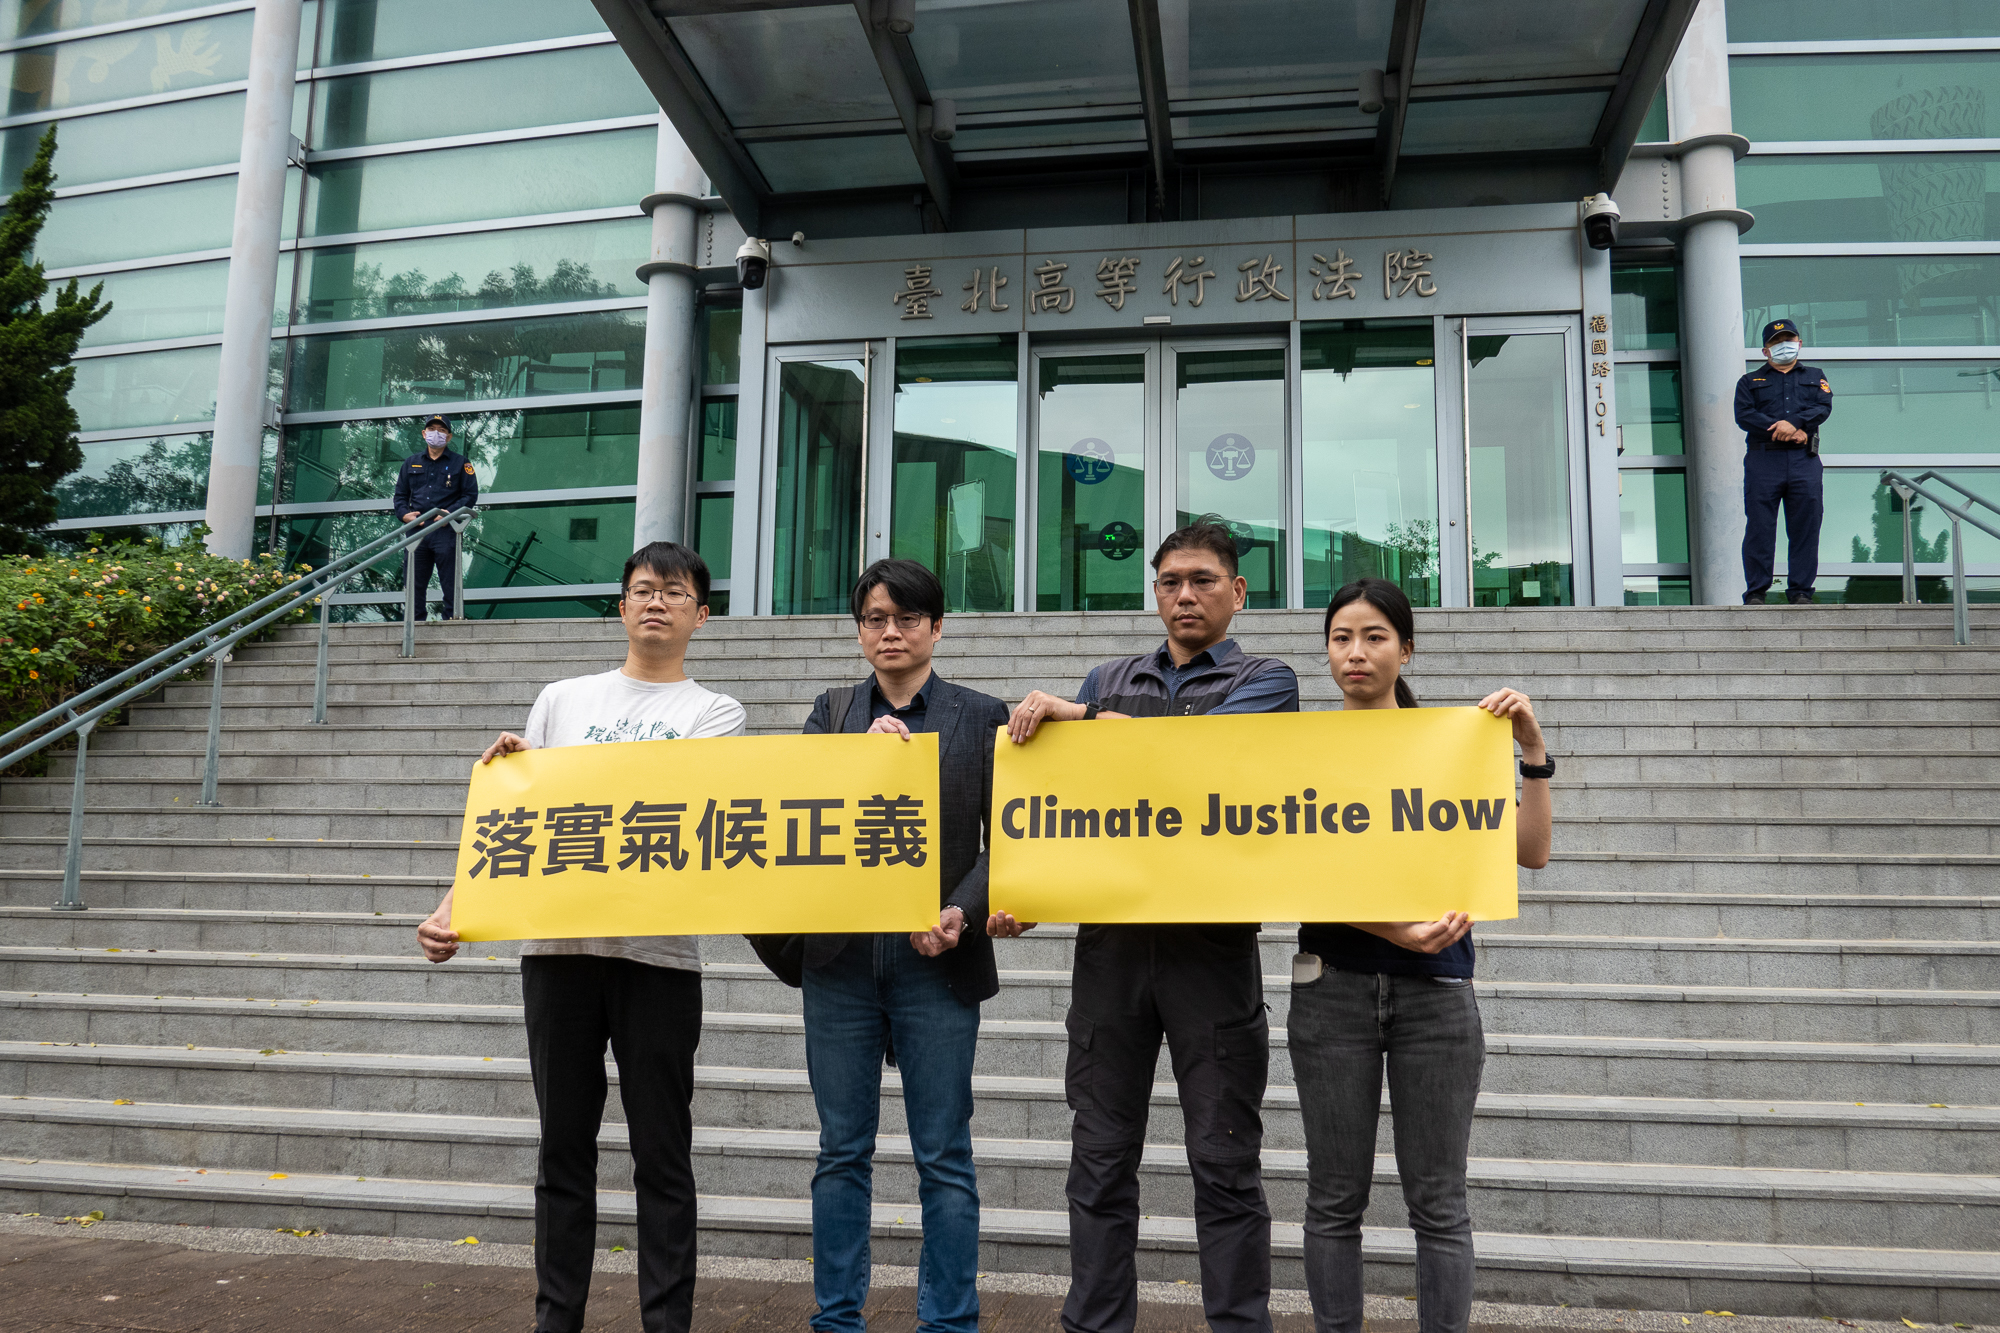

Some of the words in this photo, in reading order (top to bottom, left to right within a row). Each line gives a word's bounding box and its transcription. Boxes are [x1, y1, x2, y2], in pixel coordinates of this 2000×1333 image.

[893, 247, 1437, 320] 臺北高等行政法院
[1589, 315, 1611, 436] 福國路101
[469, 794, 928, 879] 落實氣候正義
[1001, 795, 1182, 840] Climate
[1201, 788, 1370, 837] Justice
[1391, 788, 1506, 832] Now
